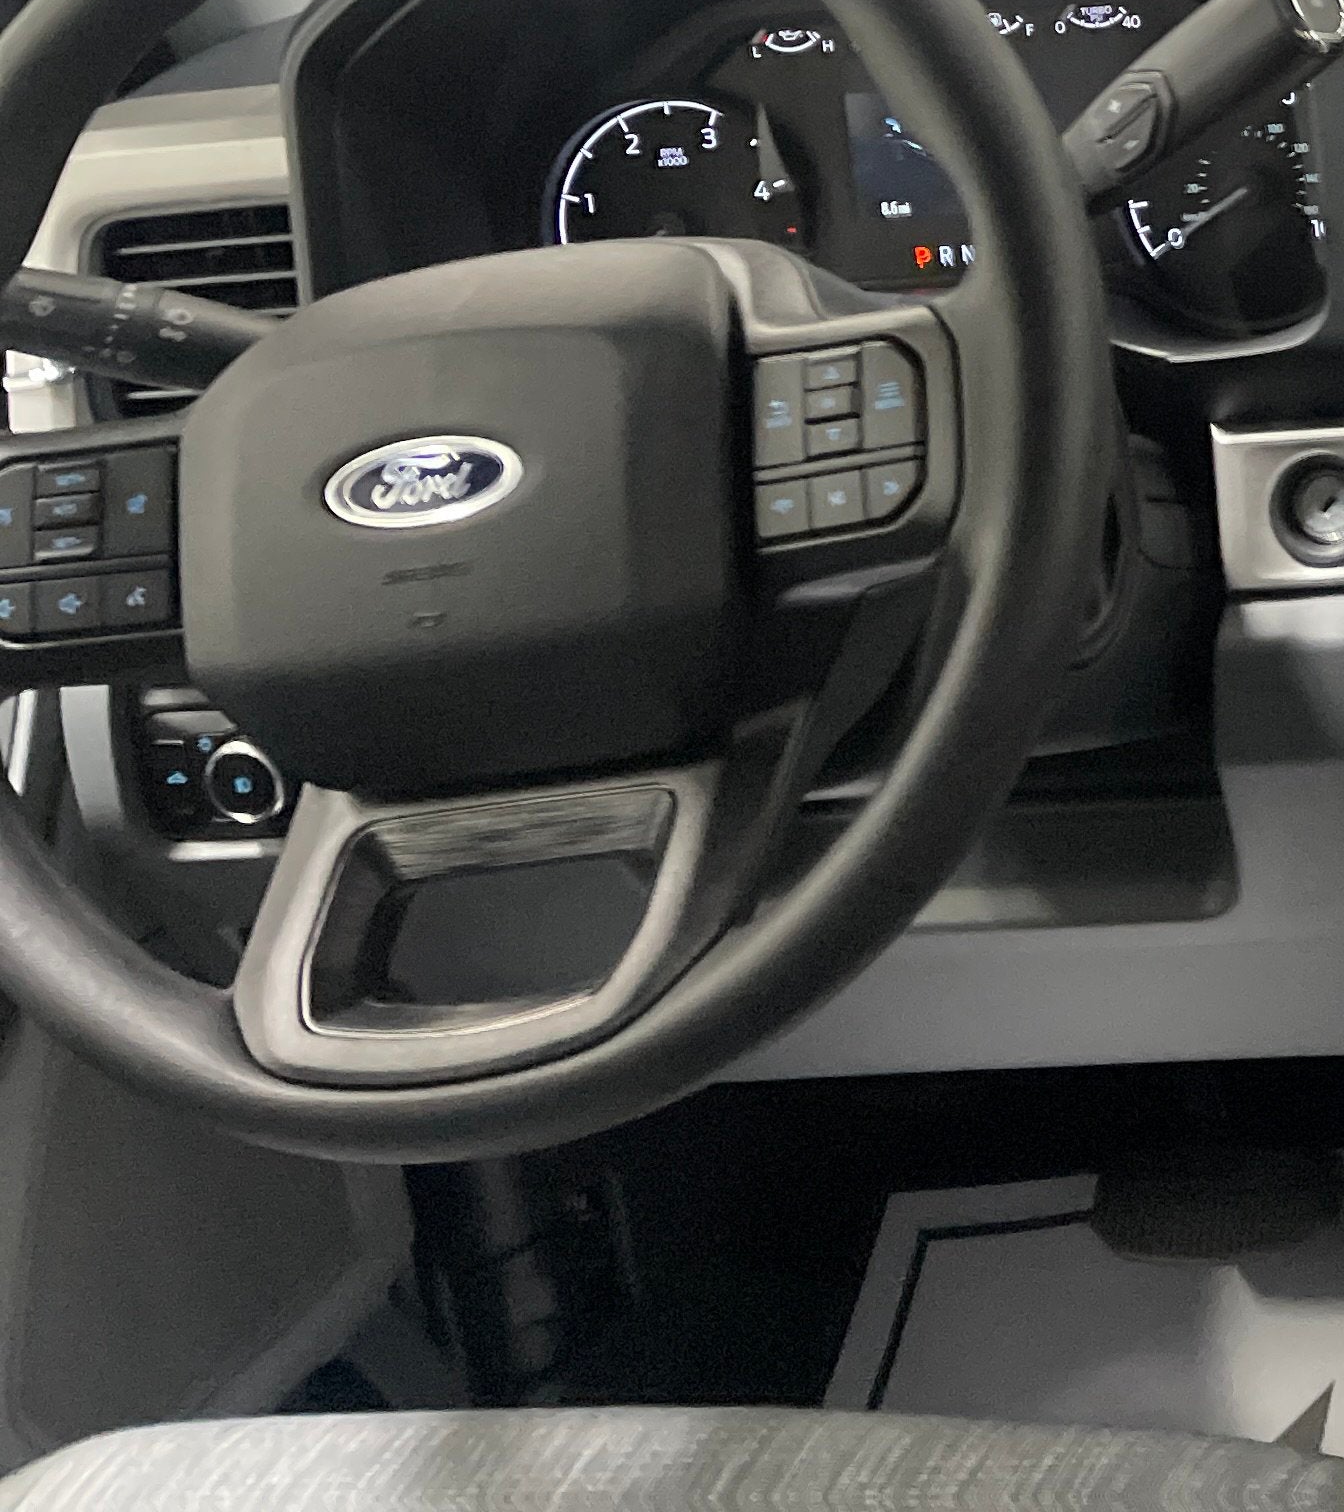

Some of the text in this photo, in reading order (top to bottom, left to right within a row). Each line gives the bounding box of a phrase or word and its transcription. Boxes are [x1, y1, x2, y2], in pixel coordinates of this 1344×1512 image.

[1025, 23, 1035, 37] F
[1122, 14, 1141, 29] 40
[751, 46, 762, 59] L
[822, 39, 835, 52] H
[624, 133, 641, 155] 2
[700, 127, 718, 149] 3
[753, 179, 771, 202] 4
[583, 192, 596, 214] 1
[914, 244, 976, 269] P R N
[370, 444, 474, 510] Ford
